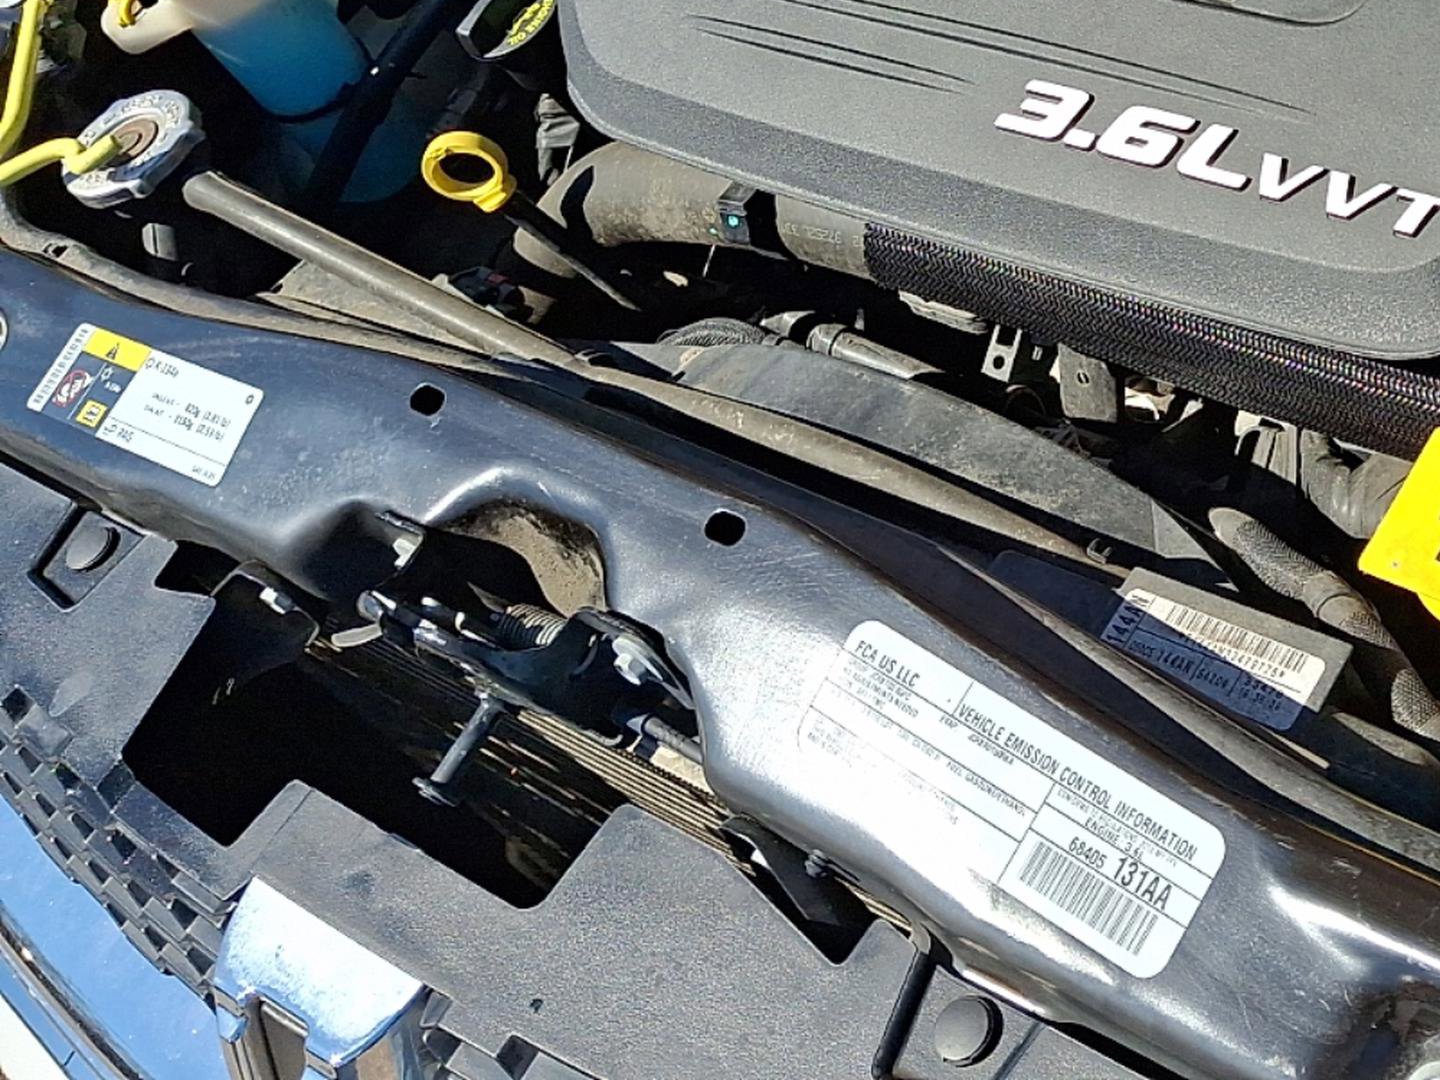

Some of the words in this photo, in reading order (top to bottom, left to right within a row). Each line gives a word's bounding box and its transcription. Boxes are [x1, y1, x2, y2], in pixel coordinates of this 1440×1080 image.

[994, 79, 1252, 191] 3.6L
[853, 639, 880, 663] FCA
[877, 653, 898, 674] US
[894, 664, 921, 688] LLC
[956, 701, 1006, 742] VEHICLE
[1002, 730, 1061, 776] EMISSION
[1057, 765, 1115, 810] CONTROL
[1111, 798, 1199, 862] INFORMATION
[1067, 834, 1108, 871] 68405
[1110, 853, 1175, 911] 131AA
